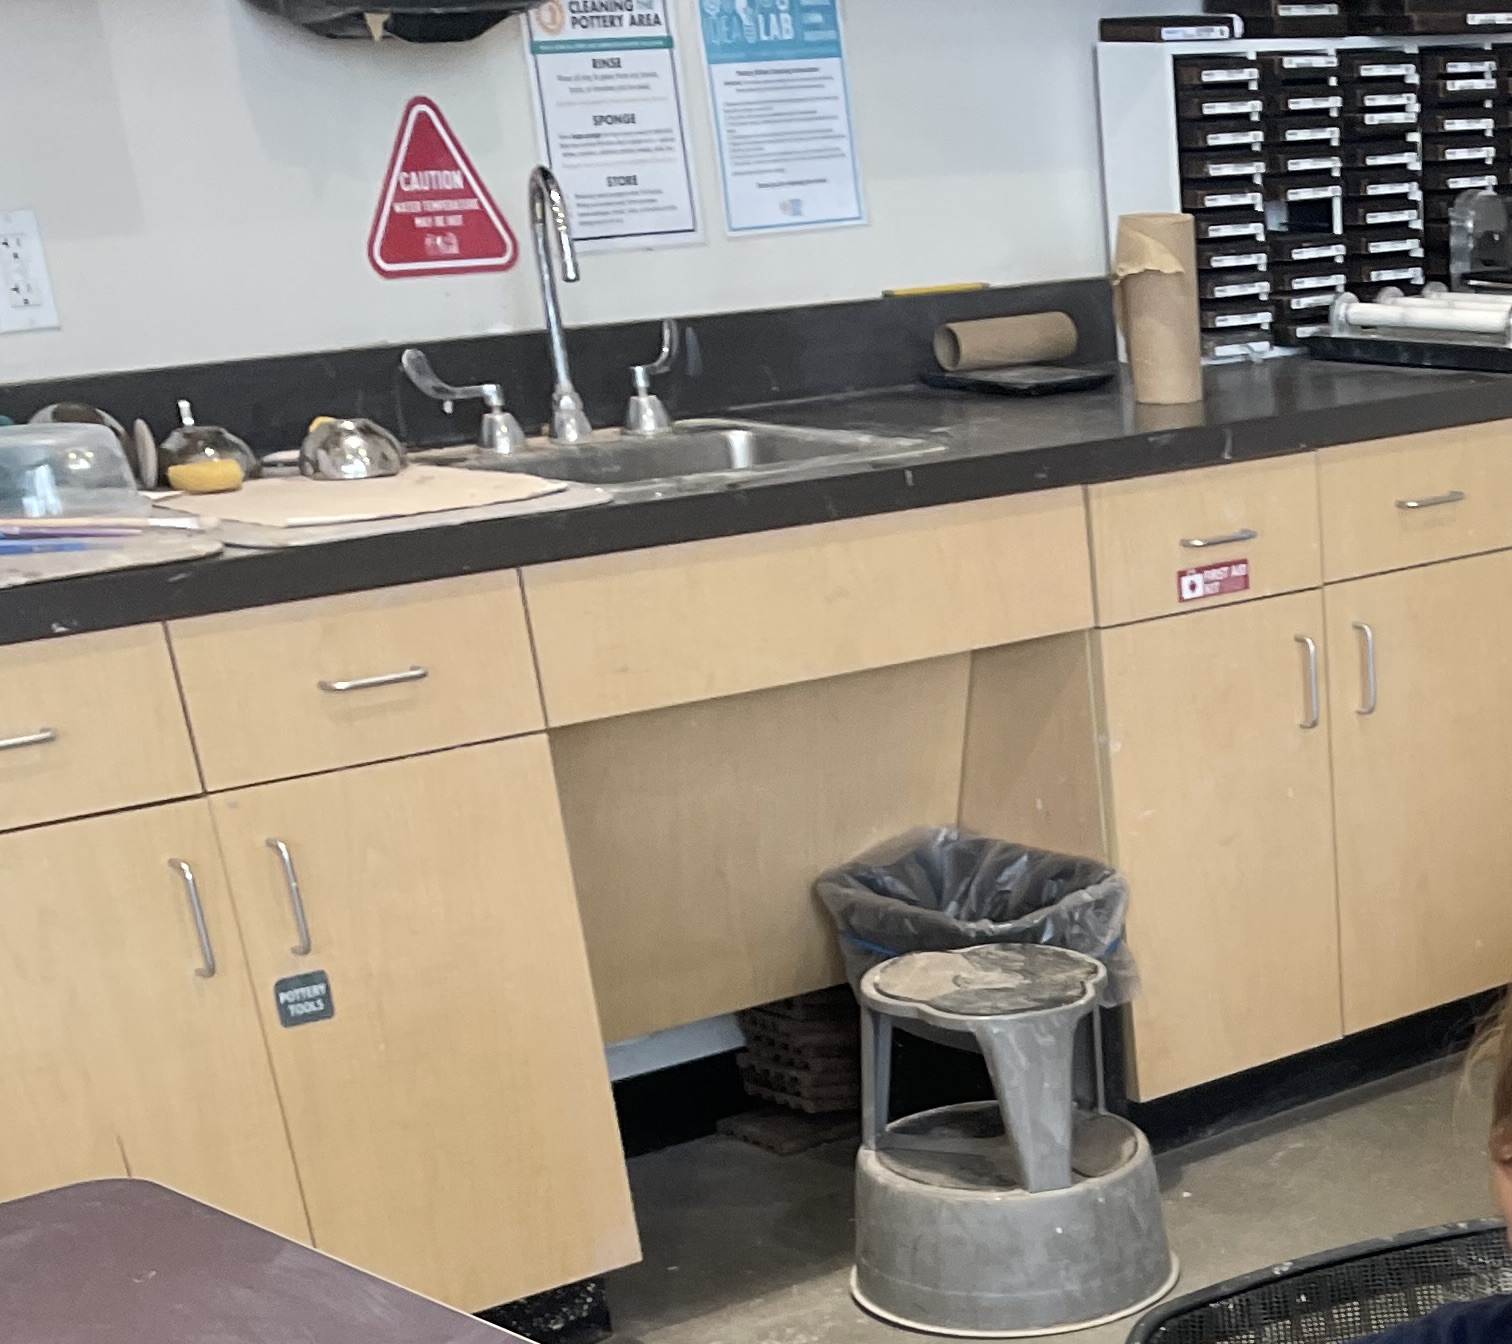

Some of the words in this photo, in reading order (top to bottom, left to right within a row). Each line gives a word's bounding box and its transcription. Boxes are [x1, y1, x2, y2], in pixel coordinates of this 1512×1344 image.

[568, 0, 634, 14] CLEANING
[570, 15, 624, 29] POTTERY
[628, 13, 662, 27] AREA
[757, 12, 794, 41] LAB
[399, 169, 465, 192] CAUTION
[279, 983, 327, 1005] POTTERY
[288, 998, 325, 1017] TOOLS
